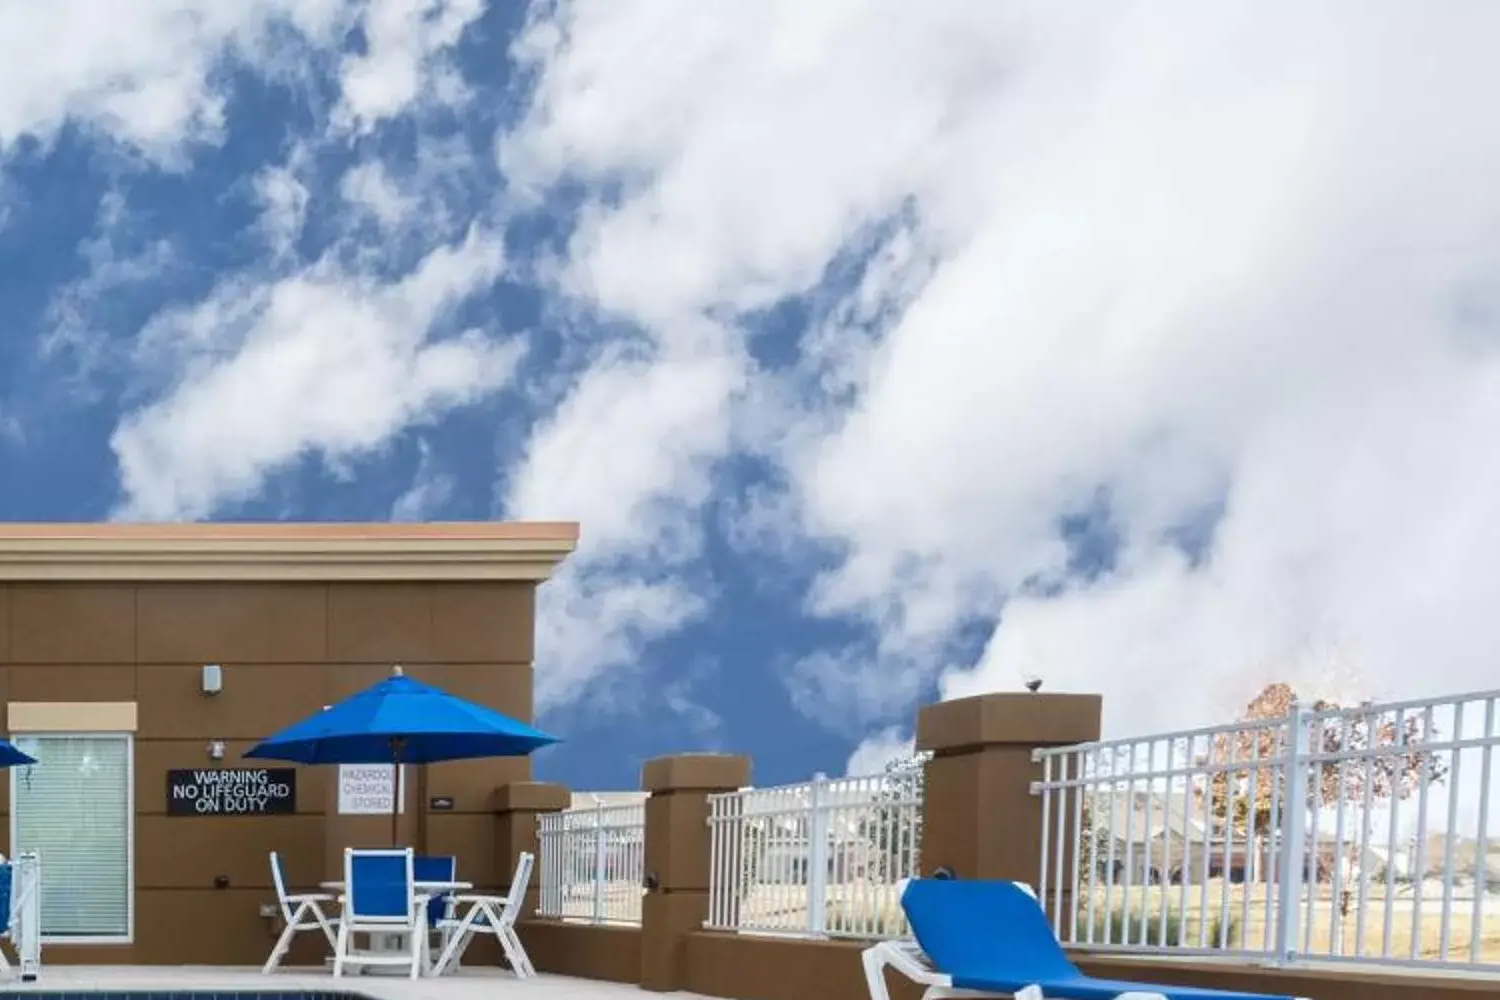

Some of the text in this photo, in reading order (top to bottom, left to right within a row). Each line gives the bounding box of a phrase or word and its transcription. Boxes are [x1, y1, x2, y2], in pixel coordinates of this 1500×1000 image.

[194, 769, 268, 785] WARNING
[173, 783, 290, 799] NO LIFEGUARD
[195, 798, 268, 812] ON DUTY
